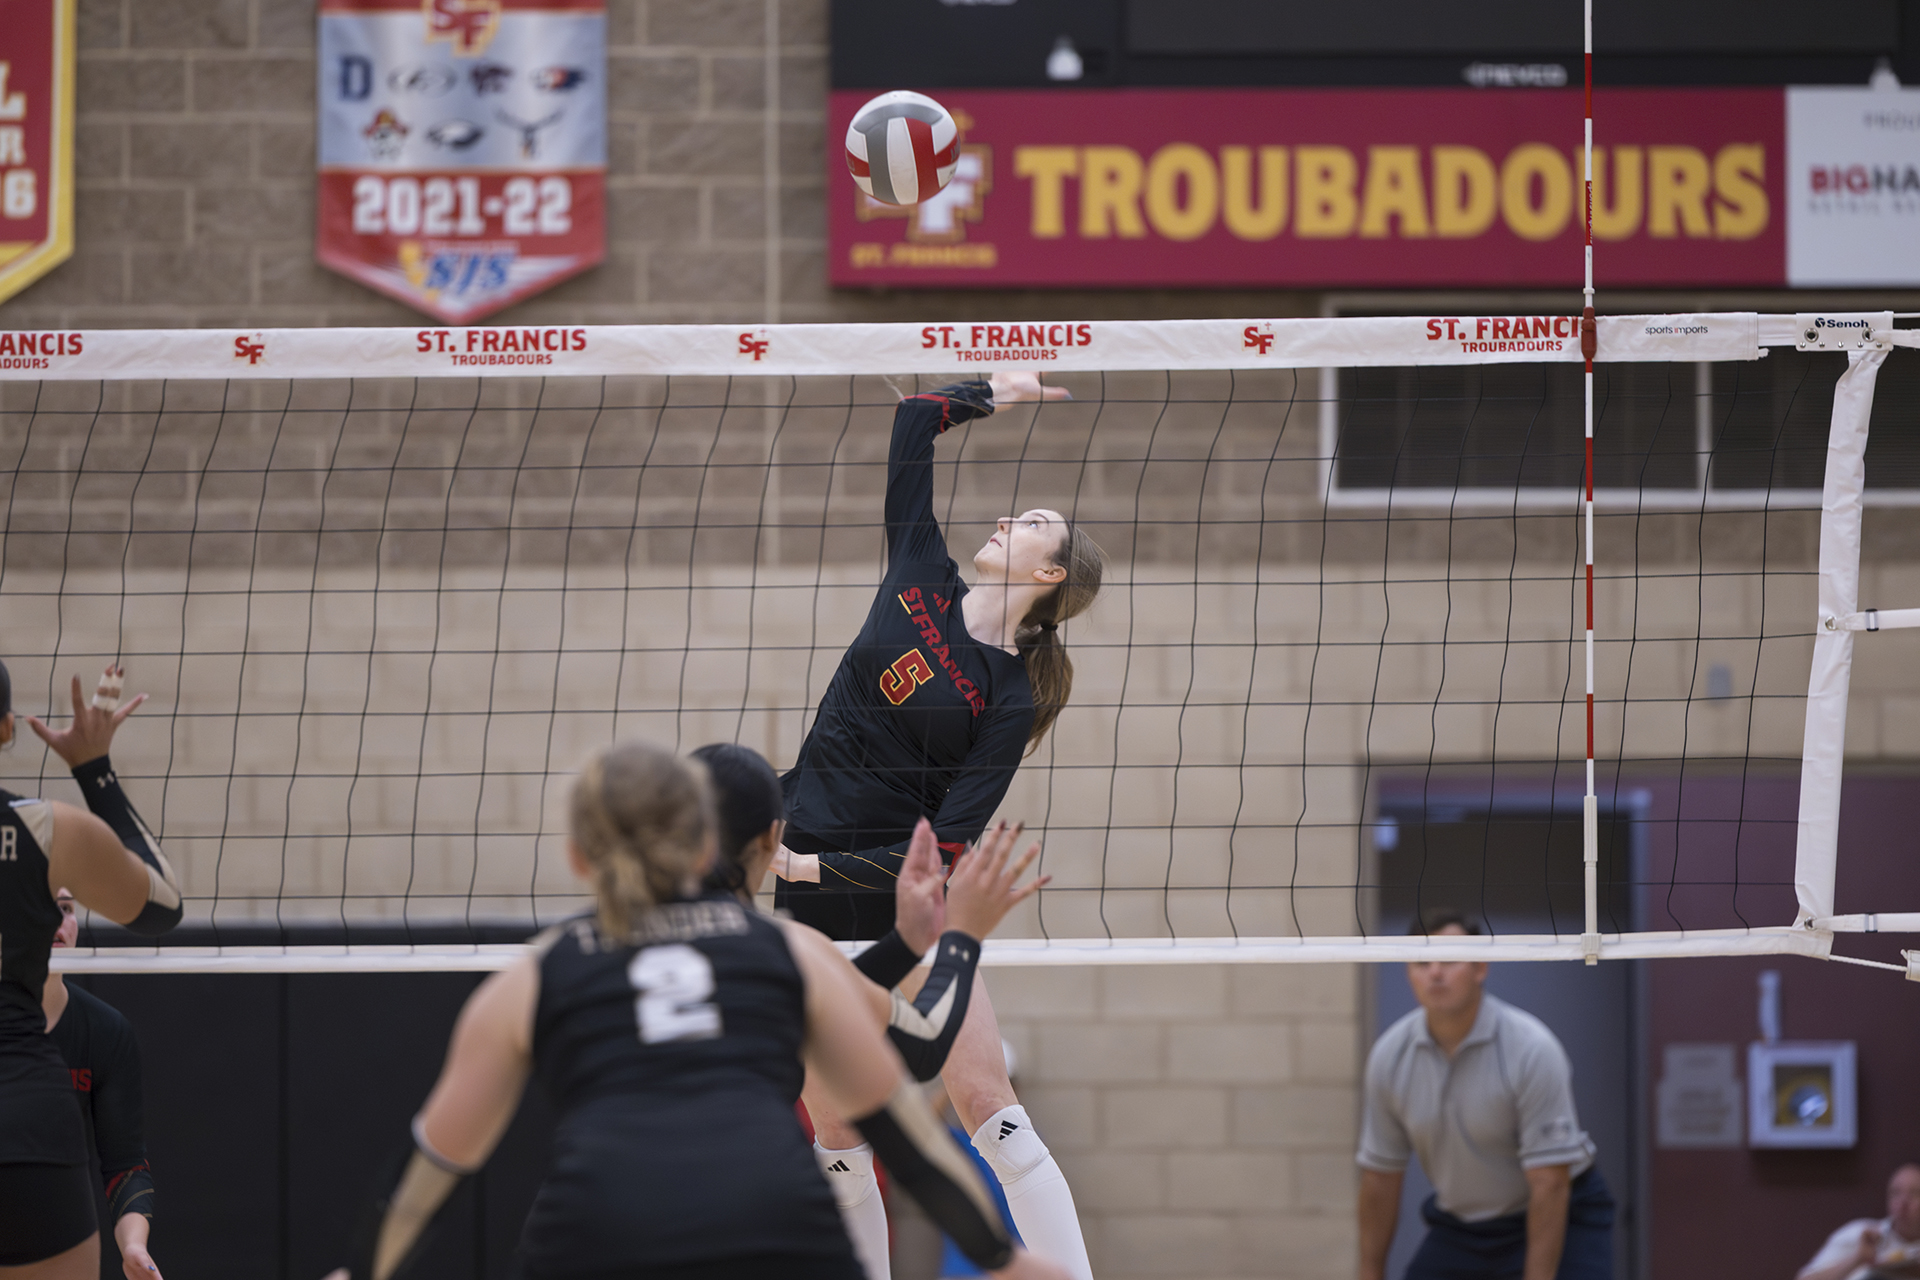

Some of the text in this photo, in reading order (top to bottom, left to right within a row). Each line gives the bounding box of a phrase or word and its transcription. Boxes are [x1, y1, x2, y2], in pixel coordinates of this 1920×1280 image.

[1015, 142, 1770, 241] TROUBADOURS
[353, 176, 573, 235] 2021-22
[921, 323, 1092, 349] ST. FRANCIS
[1426, 316, 1579, 340] ST. FRANCI
[1645, 325, 1709, 335] sports imports
[1827, 319, 1869, 328] Senoh
[235, 335, 265, 364] SF
[416, 328, 587, 353] ST. FRANCIS
[738, 332, 769, 361] SF
[1243, 326, 1275, 355] SF
[1461, 340, 1563, 353] TROUBADOURS
[451, 354, 553, 366] TROUBADOURS
[956, 349, 1058, 361] TROUBADOURS
[879, 647, 935, 706] 5
[911, 612, 985, 718] FRANCIS
[628, 943, 723, 1045] 2
